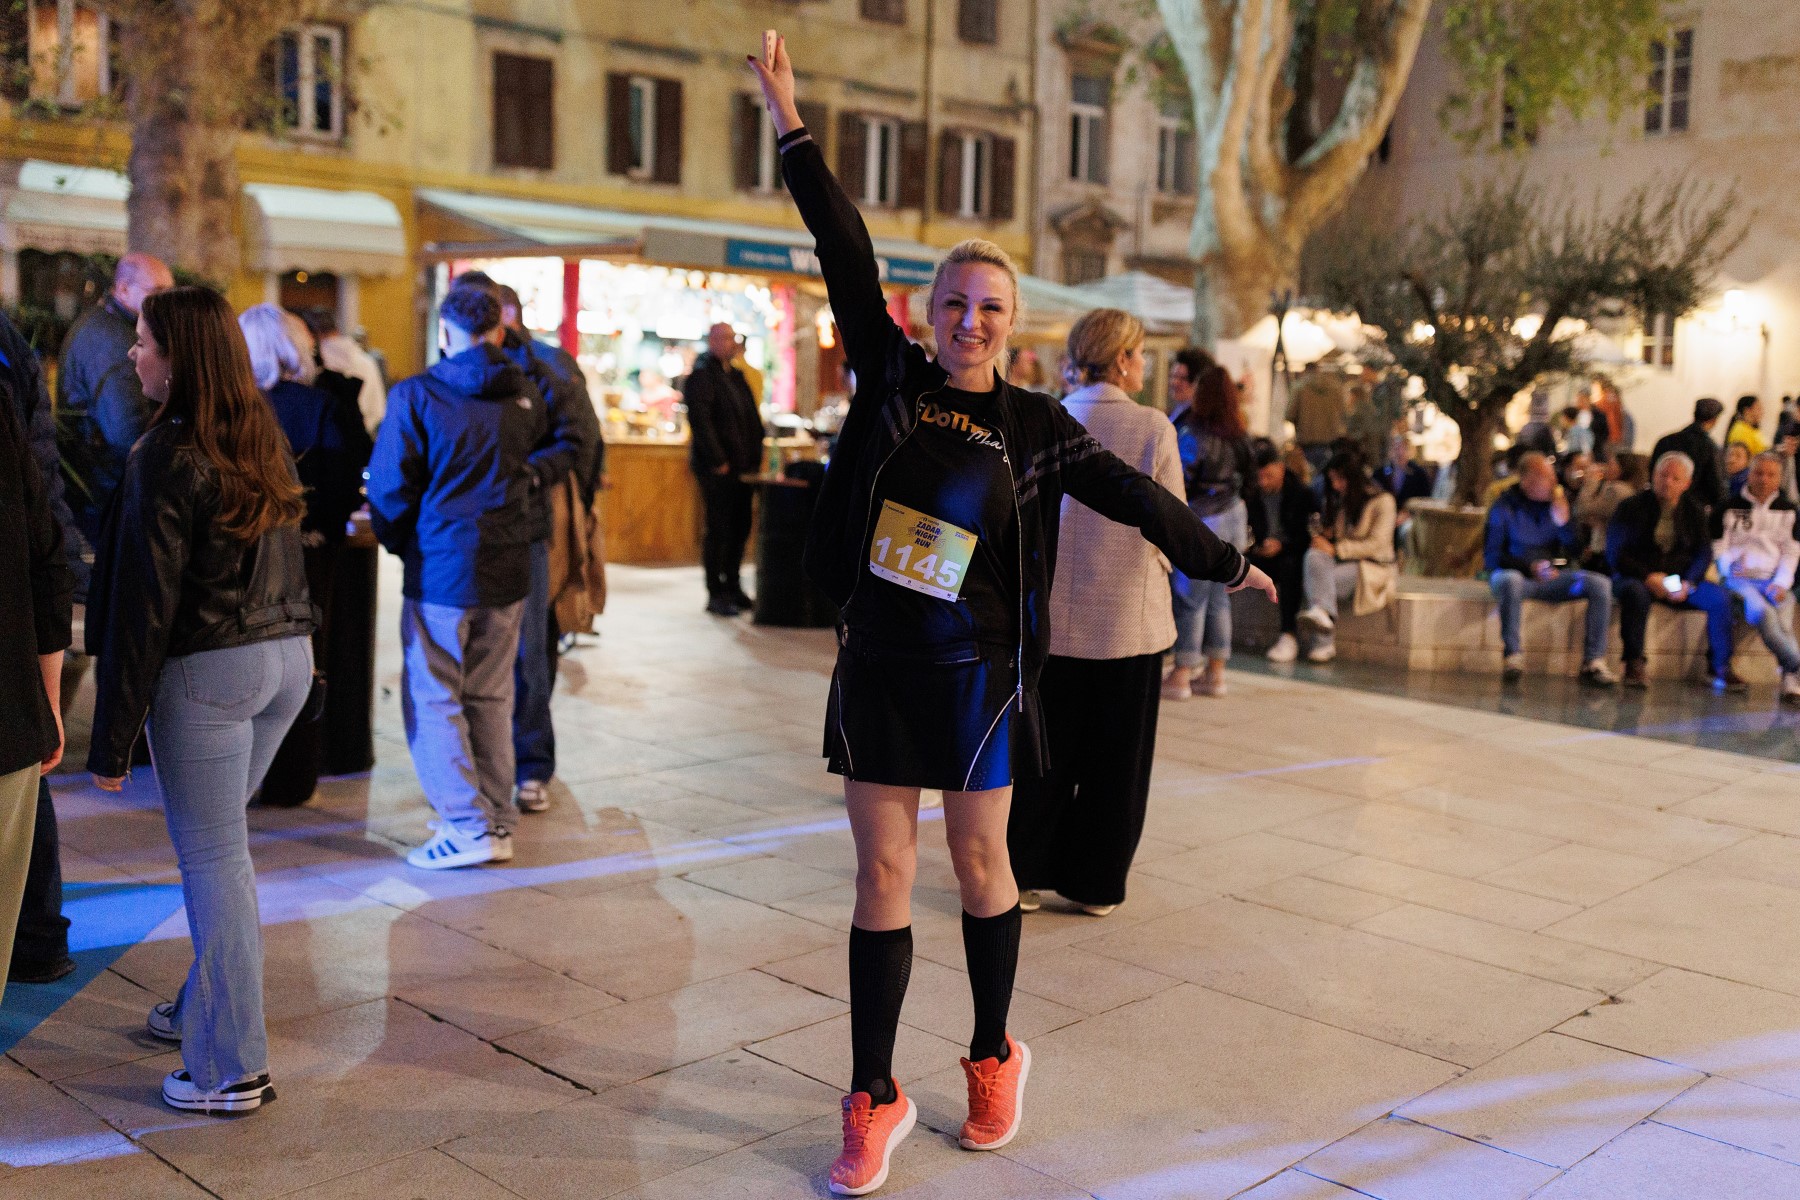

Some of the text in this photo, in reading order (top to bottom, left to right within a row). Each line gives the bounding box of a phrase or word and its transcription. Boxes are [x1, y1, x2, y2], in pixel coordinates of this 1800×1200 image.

[917, 521, 941, 535] ZADAR
[915, 529, 939, 541] NIGHT
[914, 538, 931, 548] RUN
[876, 536, 961, 588] 1145
